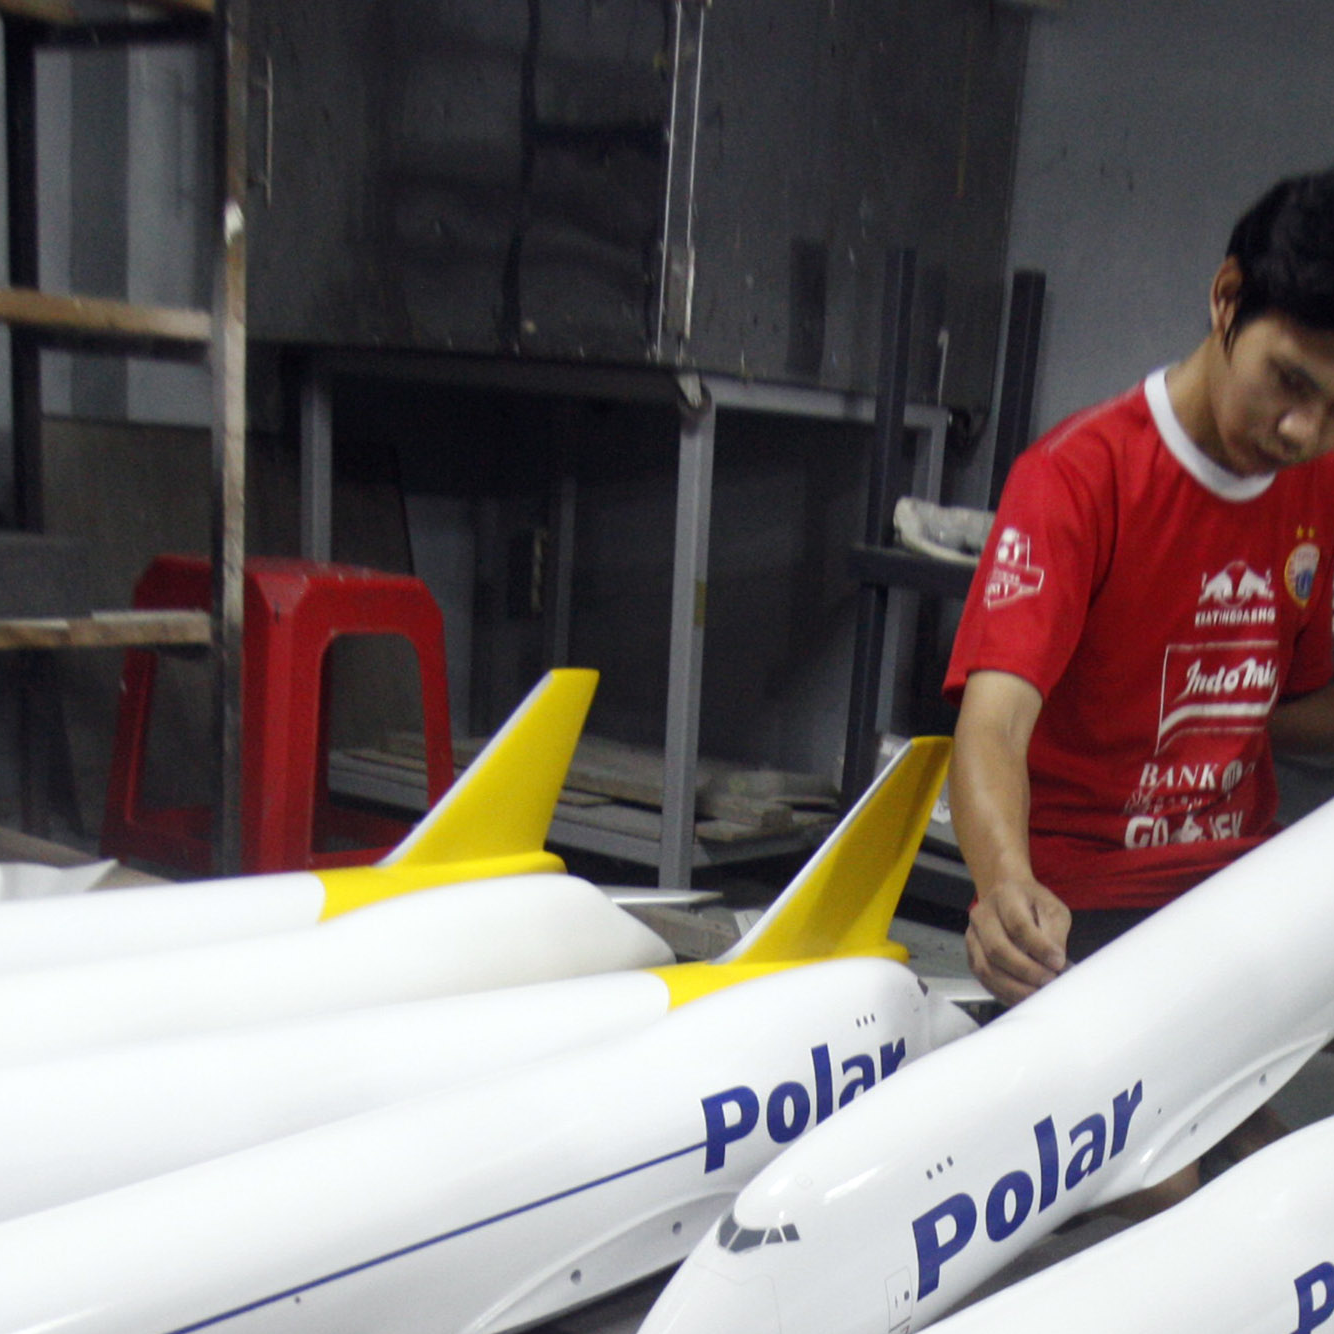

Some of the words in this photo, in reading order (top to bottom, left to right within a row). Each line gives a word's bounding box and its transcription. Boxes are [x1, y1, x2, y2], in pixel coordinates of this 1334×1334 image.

[1139, 762, 1220, 790] BANK
[700, 1037, 906, 1174] Polar
[911, 1079, 1143, 1302] Polar
